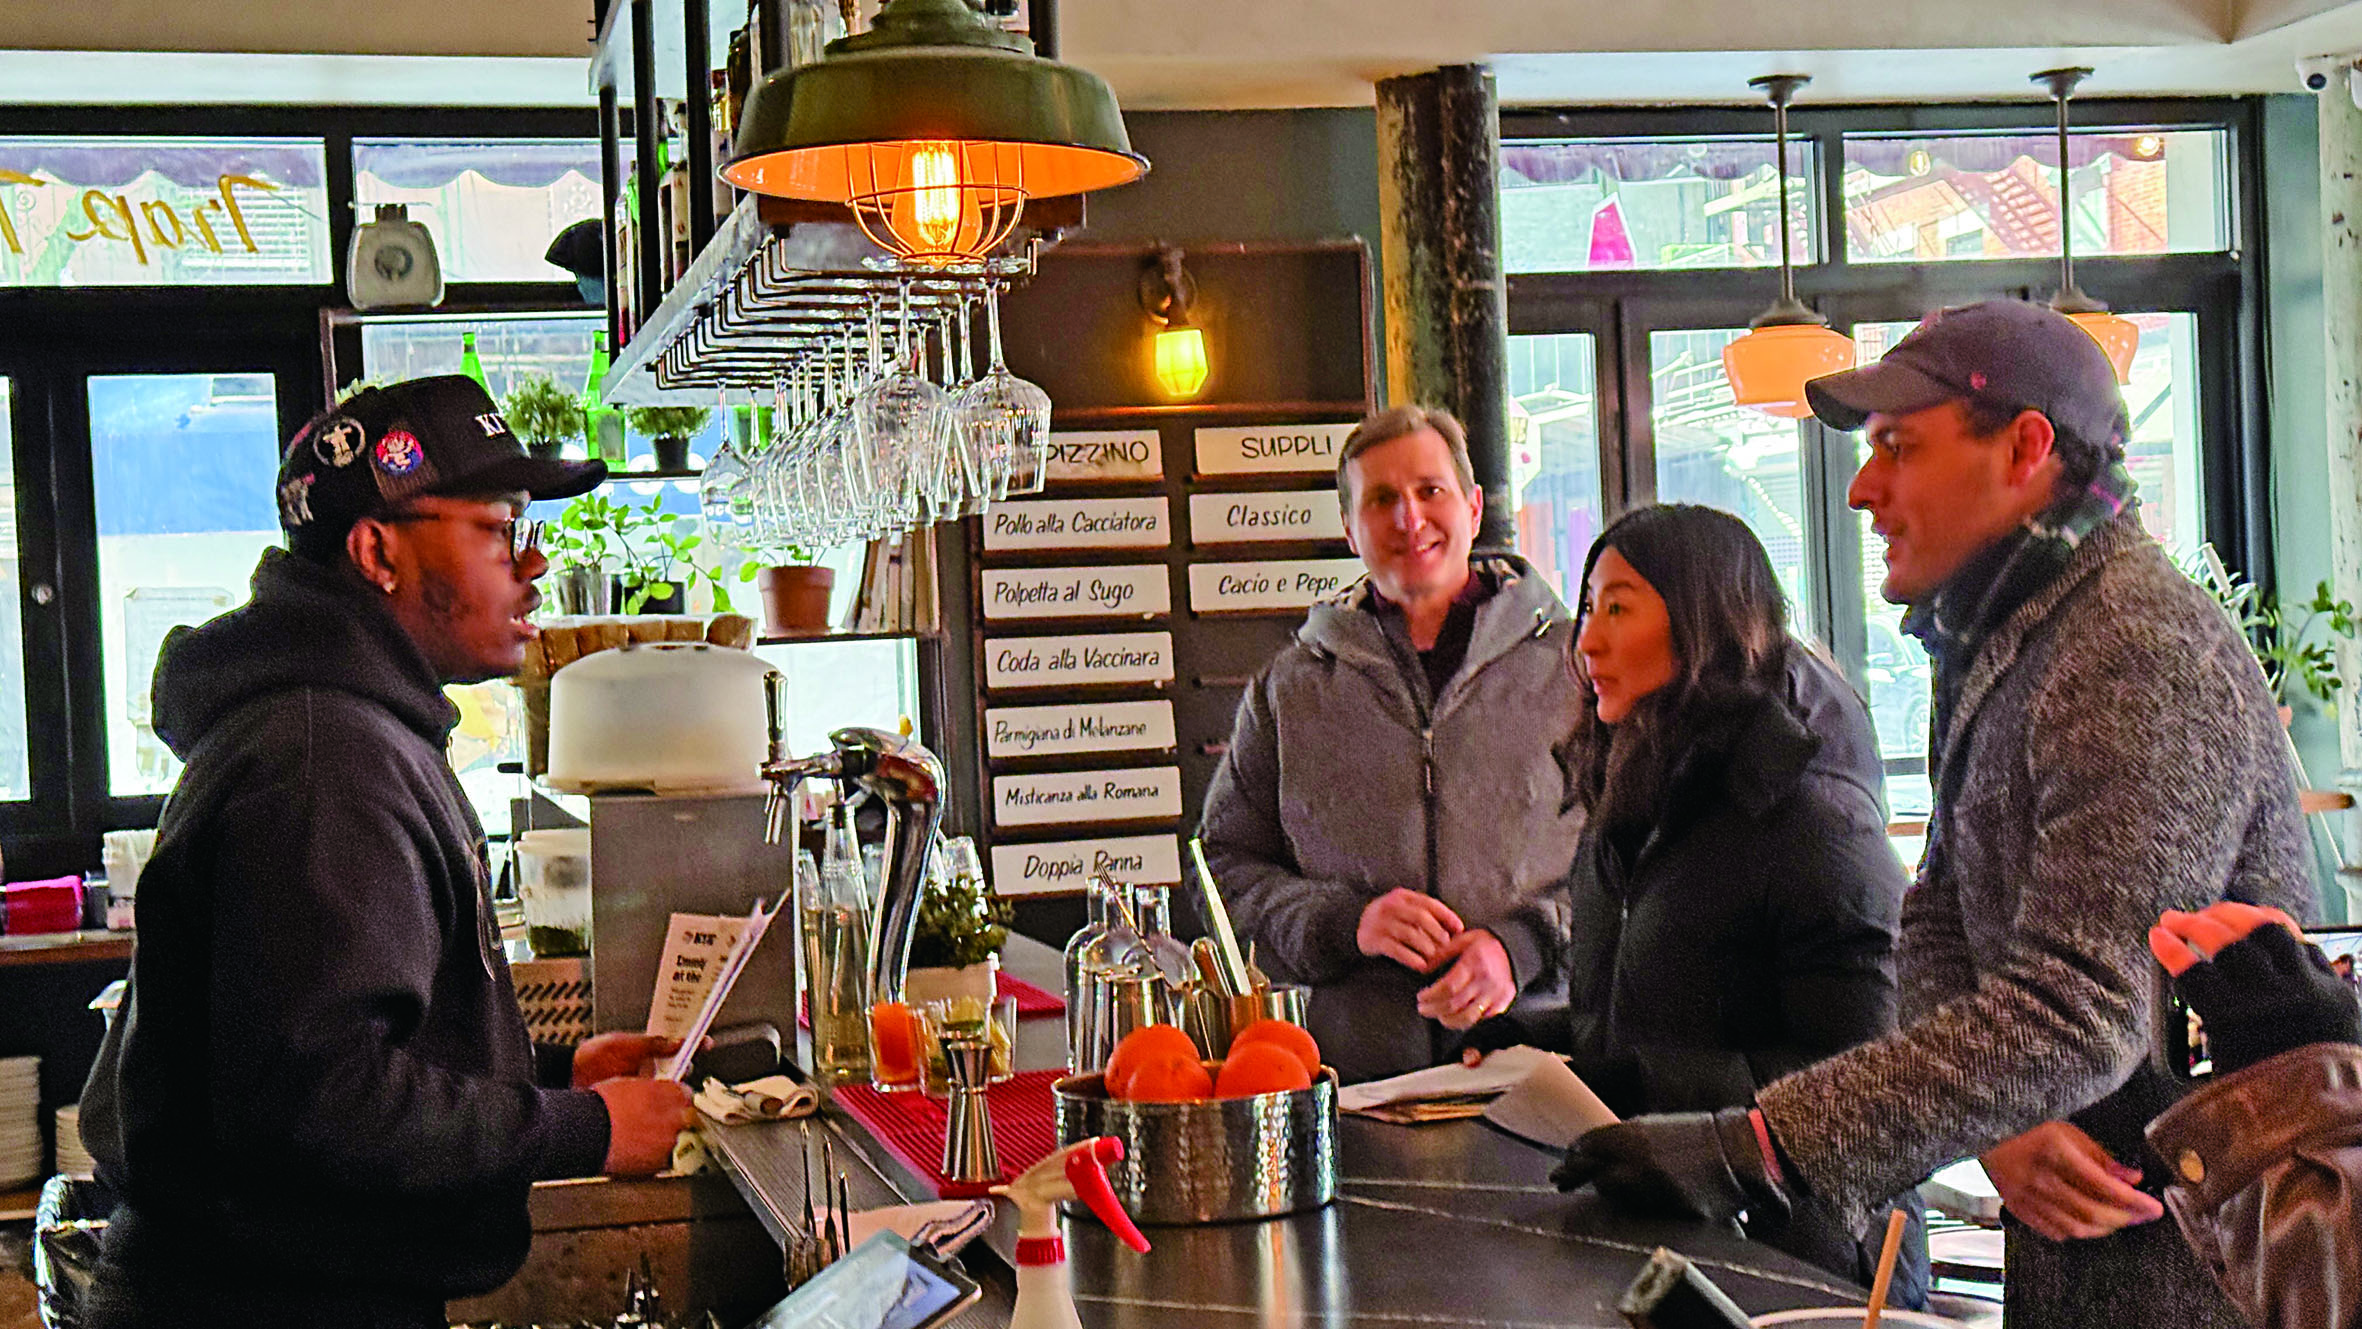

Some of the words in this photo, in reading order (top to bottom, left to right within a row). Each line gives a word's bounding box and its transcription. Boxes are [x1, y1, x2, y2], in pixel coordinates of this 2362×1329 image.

[1046, 440, 1150, 464] PIZZINO
[1241, 435, 1332, 459] SUPPLI
[994, 513, 1033, 536] Pollo
[1036, 512, 1065, 534] alla
[1071, 511, 1157, 533] Cacciatora
[1226, 503, 1312, 528] Classico
[994, 581, 1058, 607] Polpetta
[1063, 580, 1081, 602] al
[1088, 578, 1134, 609] Sugo
[1218, 572, 1269, 595] Cacio
[1276, 578, 1287, 593] e
[1295, 572, 1339, 597] Pepe
[997, 649, 1040, 673] Coda
[1048, 648, 1077, 670] alla
[1084, 647, 1160, 669] Vaccinara
[994, 720, 1060, 750] Parmigiana
[1063, 717, 1075, 740] di
[1080, 715, 1147, 738] Melanzane
[1005, 787, 1073, 806] Misticanza
[1077, 784, 1098, 801] alla
[1103, 782, 1159, 800] Romana
[1024, 854, 1084, 881] Doppia
